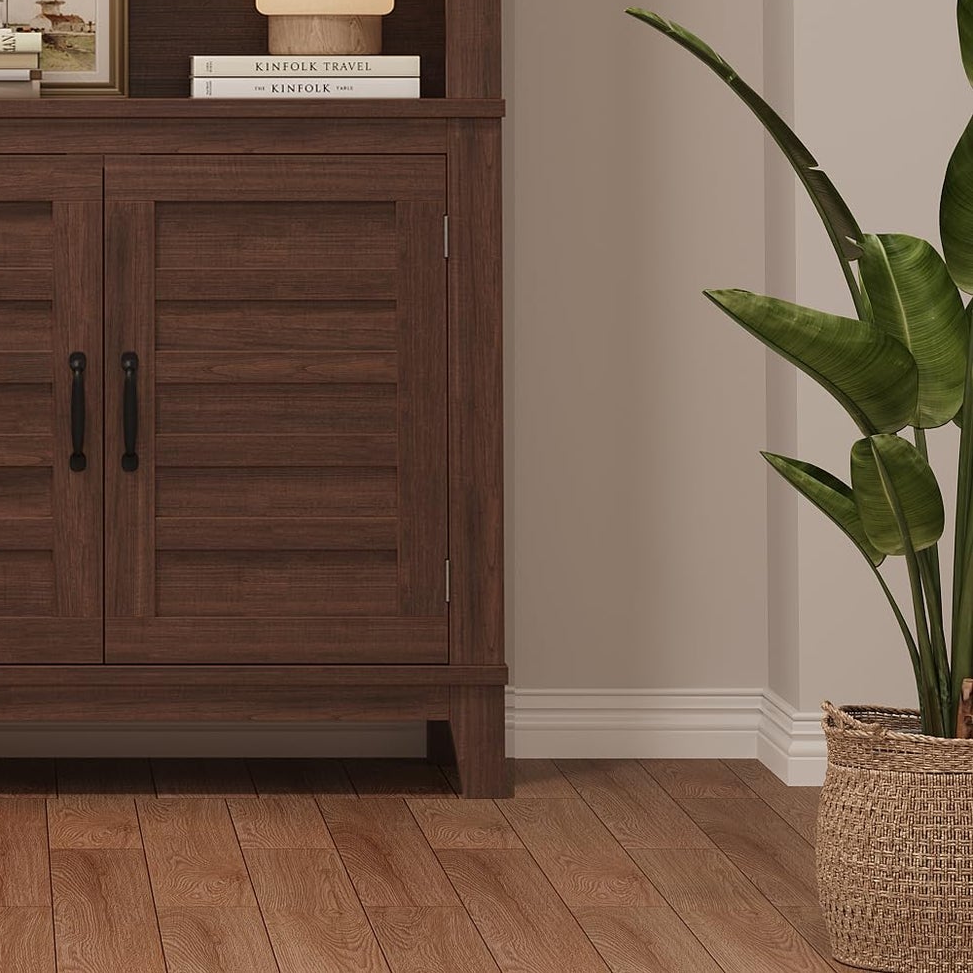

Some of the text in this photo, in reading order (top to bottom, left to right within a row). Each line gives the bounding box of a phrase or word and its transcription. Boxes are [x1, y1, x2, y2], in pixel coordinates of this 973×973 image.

[255, 61, 372, 72] KINFOLK TRAVEL
[271, 83, 331, 93] KINFOLK
